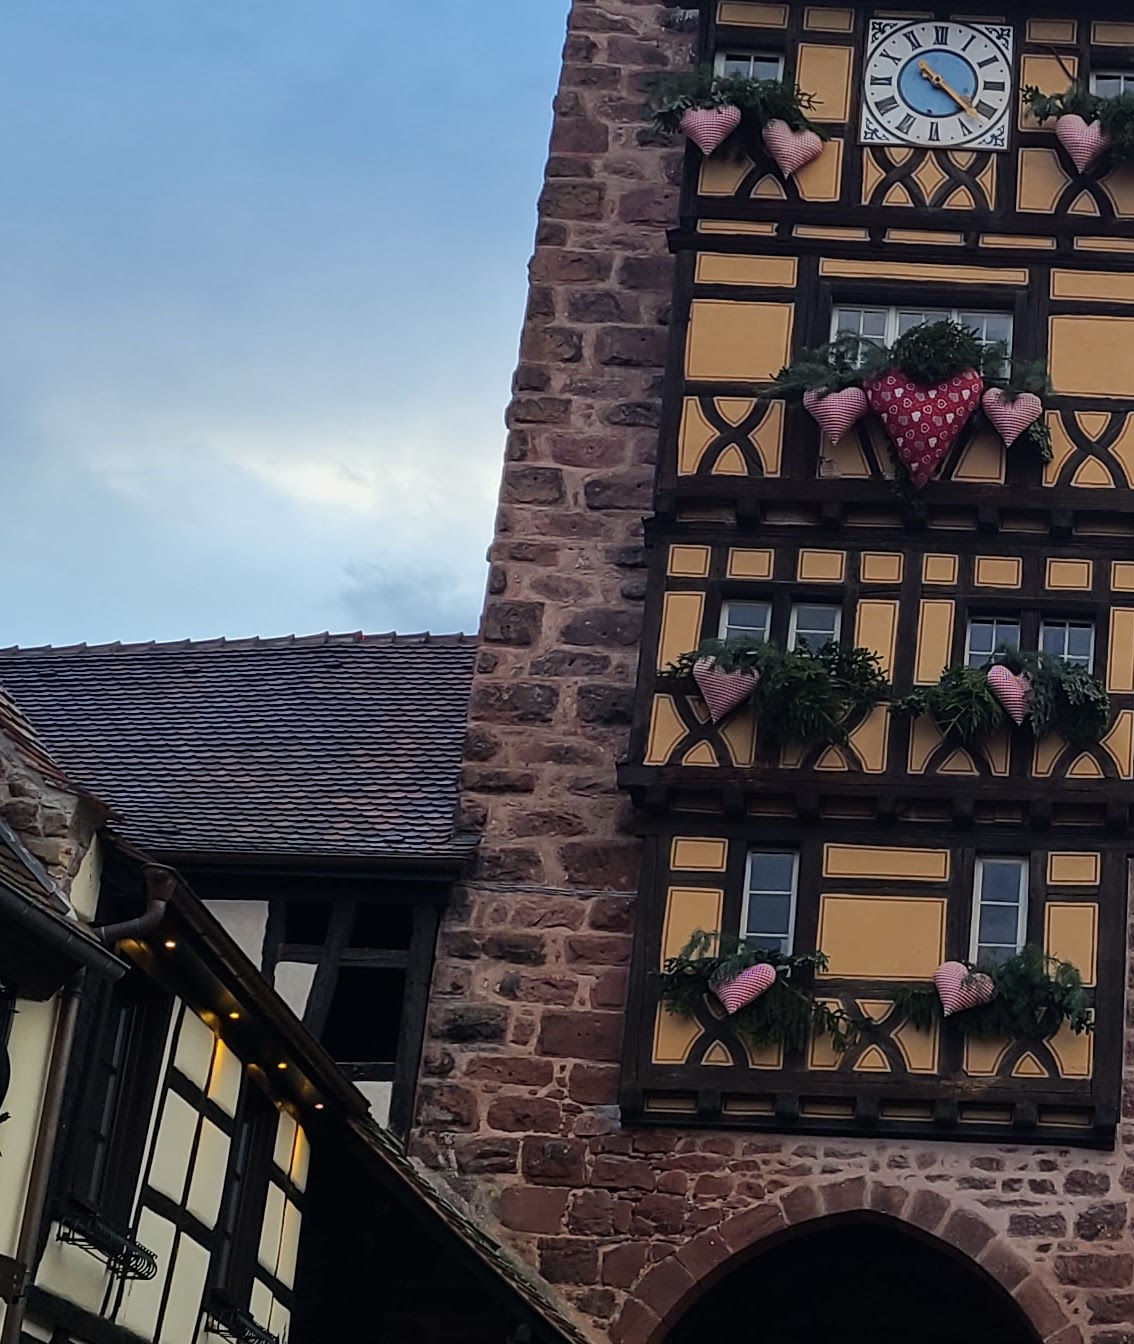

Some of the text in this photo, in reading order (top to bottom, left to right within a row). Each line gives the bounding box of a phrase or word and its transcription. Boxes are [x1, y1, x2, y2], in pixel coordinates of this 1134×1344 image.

[902, 30, 922, 51] XI
[933, 26, 949, 45] XII
[961, 34, 976, 51] I
[879, 48, 902, 65] X
[977, 54, 999, 69] II
[958, 118, 973, 136] V
